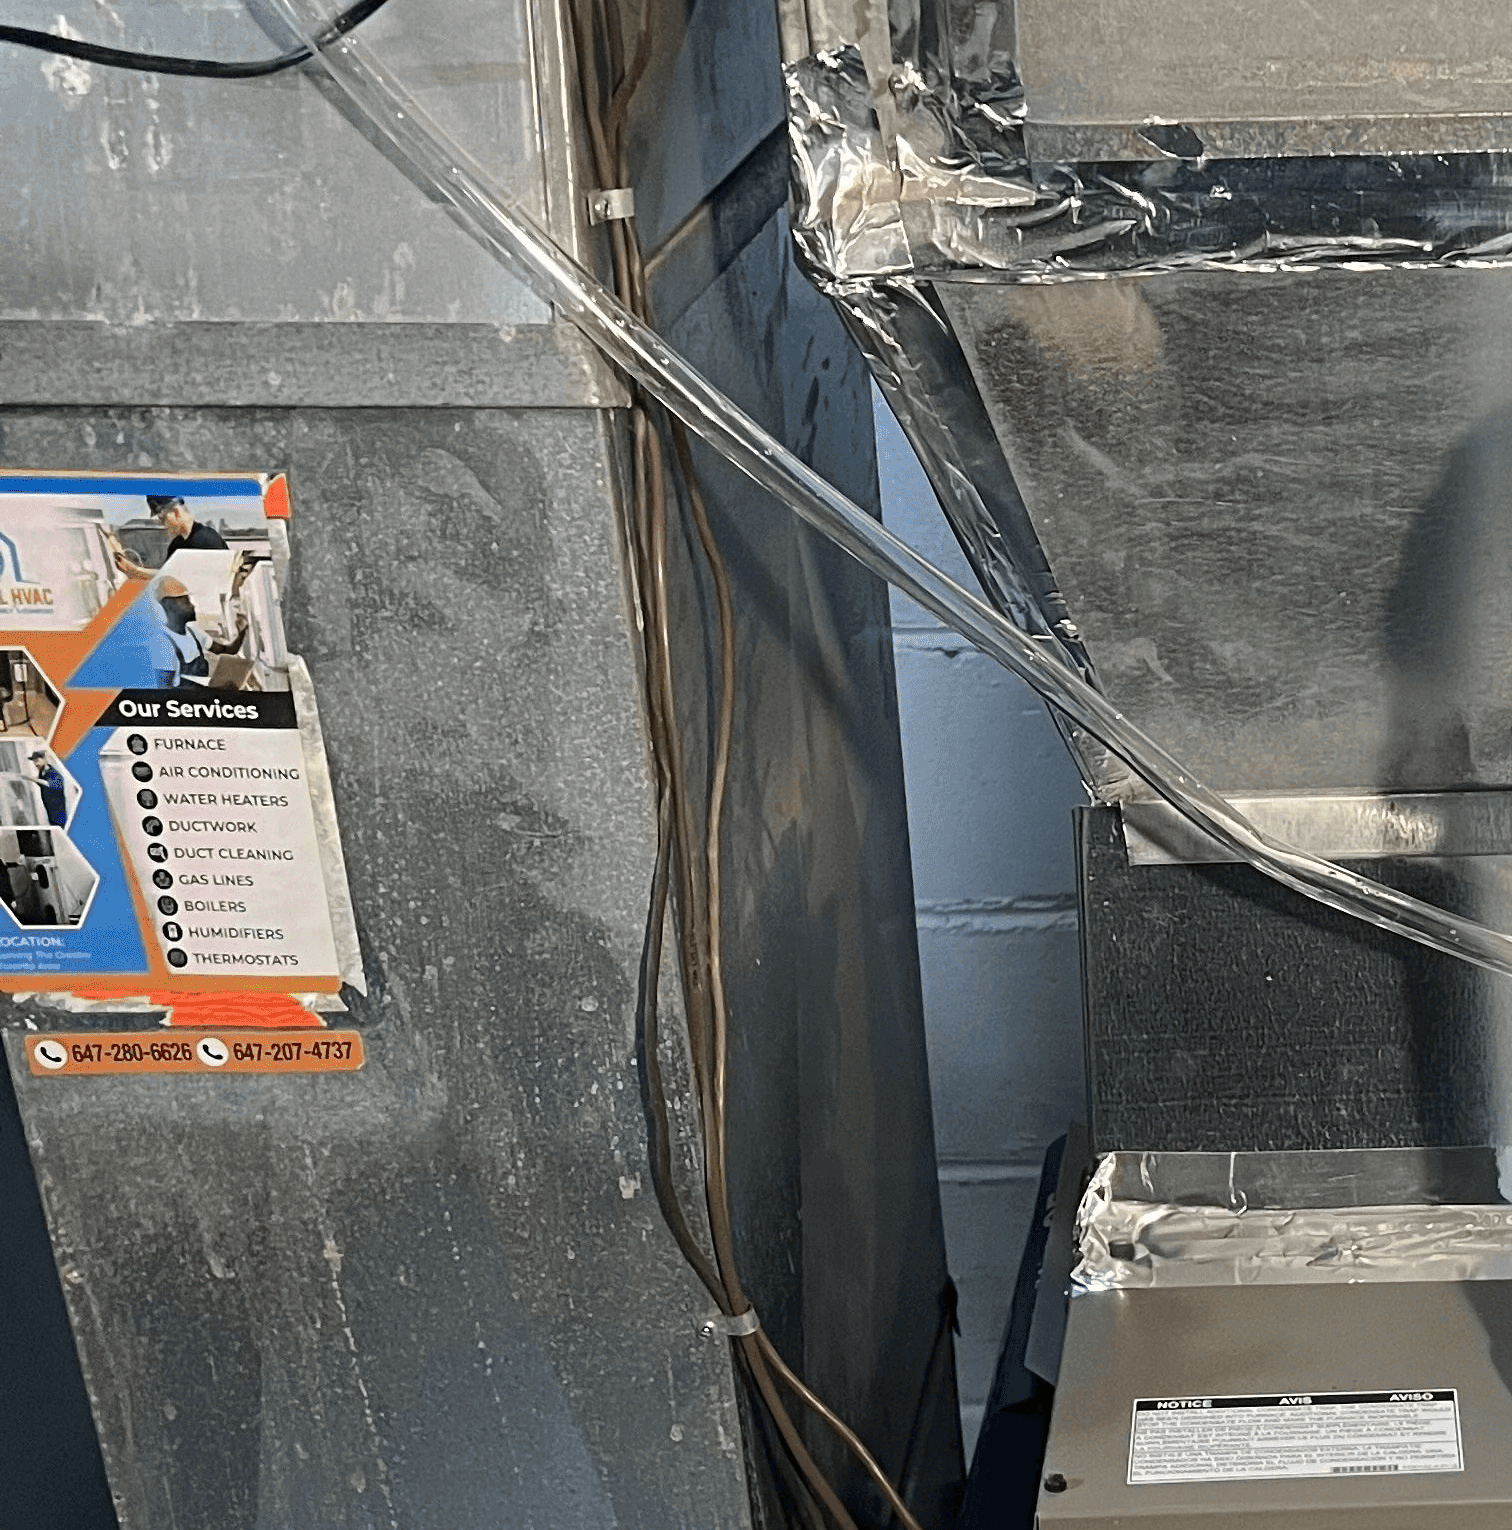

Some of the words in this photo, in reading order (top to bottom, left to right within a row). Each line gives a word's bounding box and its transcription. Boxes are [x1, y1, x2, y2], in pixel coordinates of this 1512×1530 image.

[118, 700, 162, 718] Our
[168, 699, 259, 720] Services
[154, 738, 226, 752] FURNACE
[159, 766, 186, 778] AIR
[188, 766, 300, 780] CONDITIONING
[163, 793, 217, 806] WATER
[222, 794, 289, 807] HEATERS
[168, 820, 258, 833] DUCTWORK
[173, 847, 214, 859] DUCT
[218, 848, 294, 861] CLEANING
[178, 873, 209, 886] GAS
[213, 874, 254, 887] LINES
[184, 900, 247, 913] BOILERS
[188, 926, 285, 940] HUMIDIFIERS
[193, 953, 299, 967] THERMOSTATS
[71, 1043, 193, 1062] 647-280-6626
[233, 1041, 353, 1060] 647-207-4737
[1156, 1399, 1213, 1409] NOTICE
[1279, 1396, 1313, 1406] AVIS
[1389, 1392, 1434, 1402] AVISO
